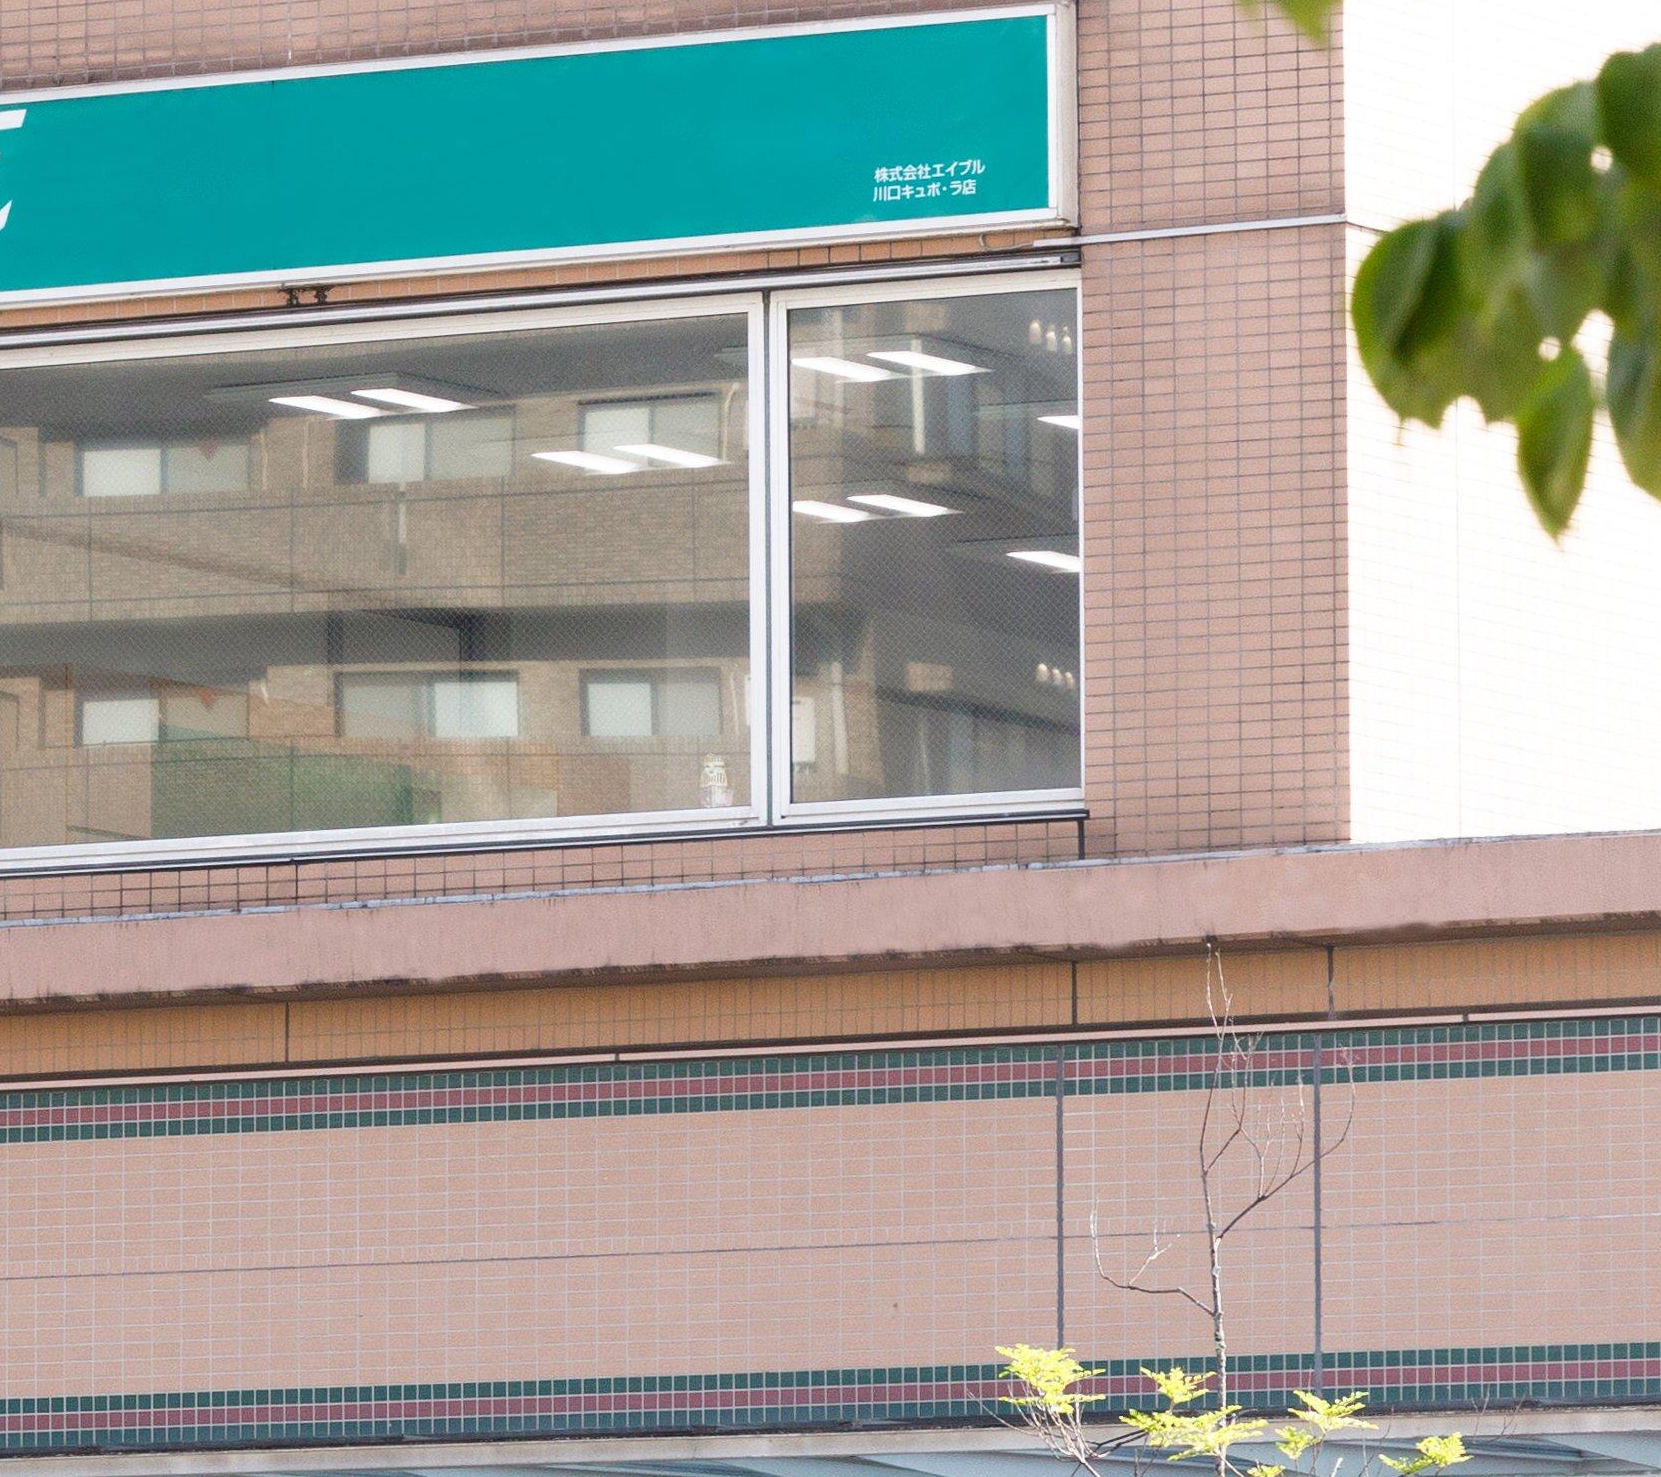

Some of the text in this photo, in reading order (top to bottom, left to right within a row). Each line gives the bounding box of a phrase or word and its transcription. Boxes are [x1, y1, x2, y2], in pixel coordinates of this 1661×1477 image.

[874, 159, 986, 183] 株式会社エイブル
